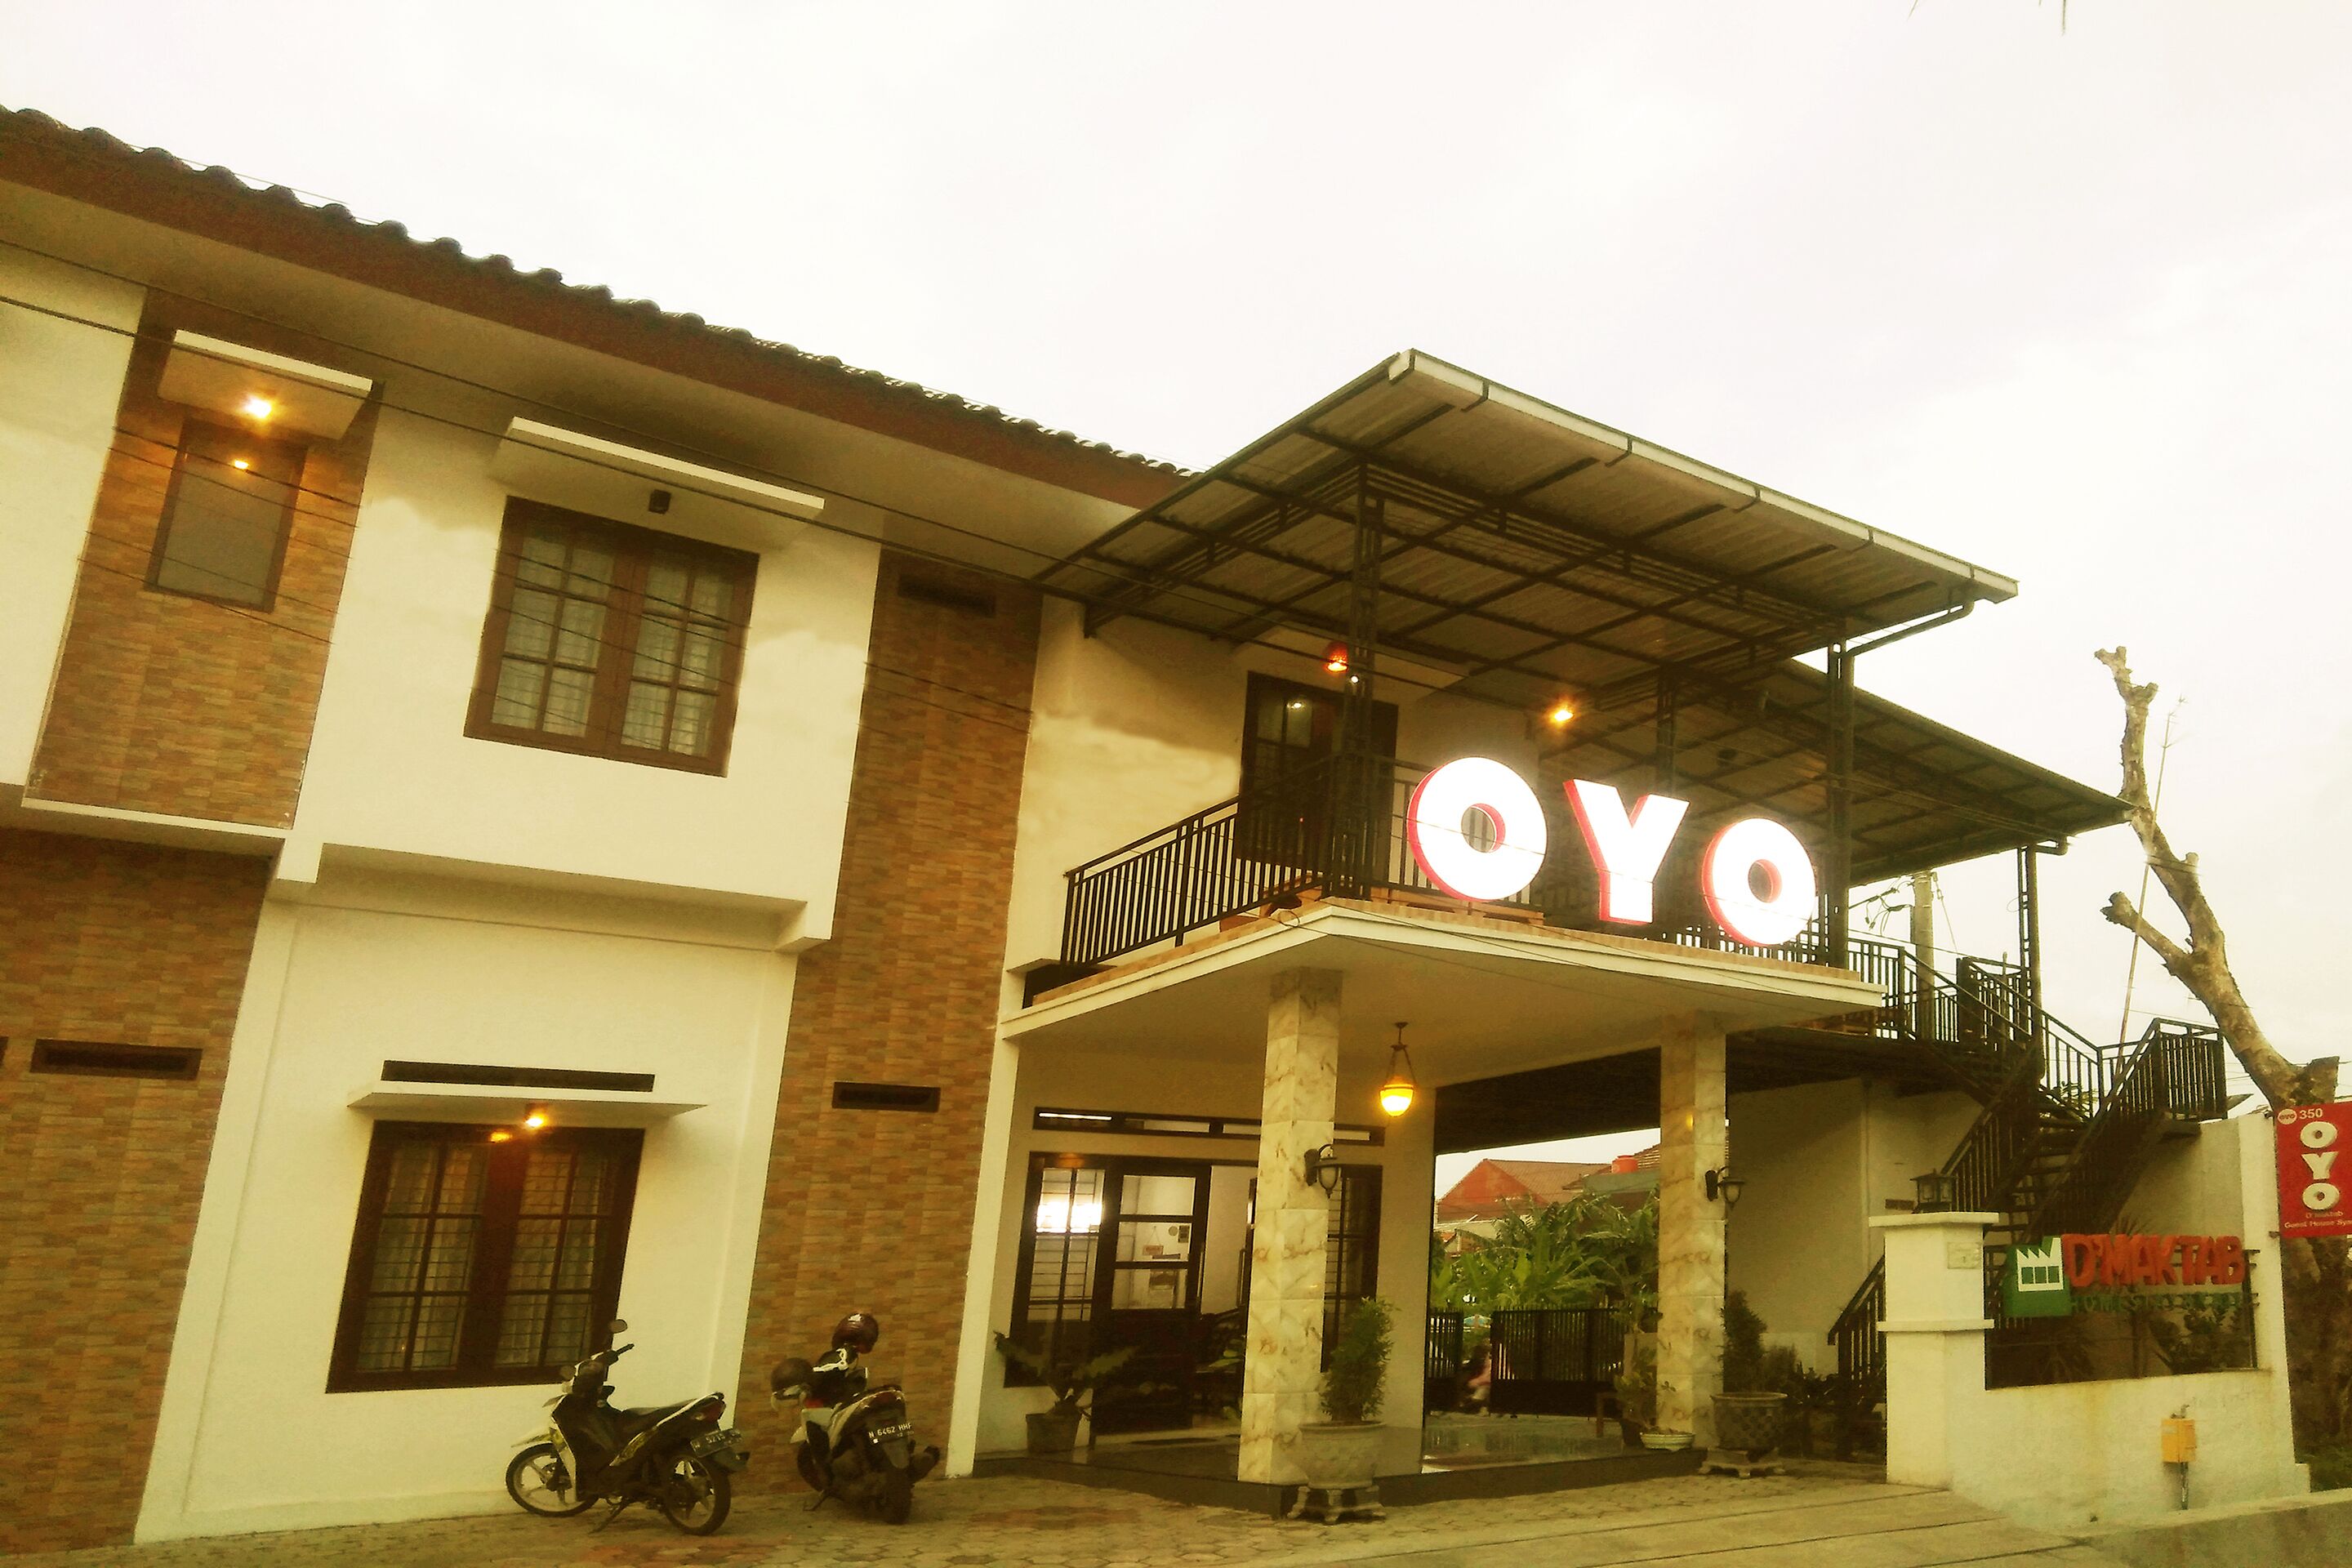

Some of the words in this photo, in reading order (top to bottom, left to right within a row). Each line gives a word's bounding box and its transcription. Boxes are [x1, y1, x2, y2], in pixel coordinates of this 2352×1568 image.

[1406, 756, 1817, 947] OYO
[2299, 1108, 2323, 1119] 350
[2300, 1121, 2341, 1210] OYO
[2061, 1233, 2245, 1287] D'MAKTAB
